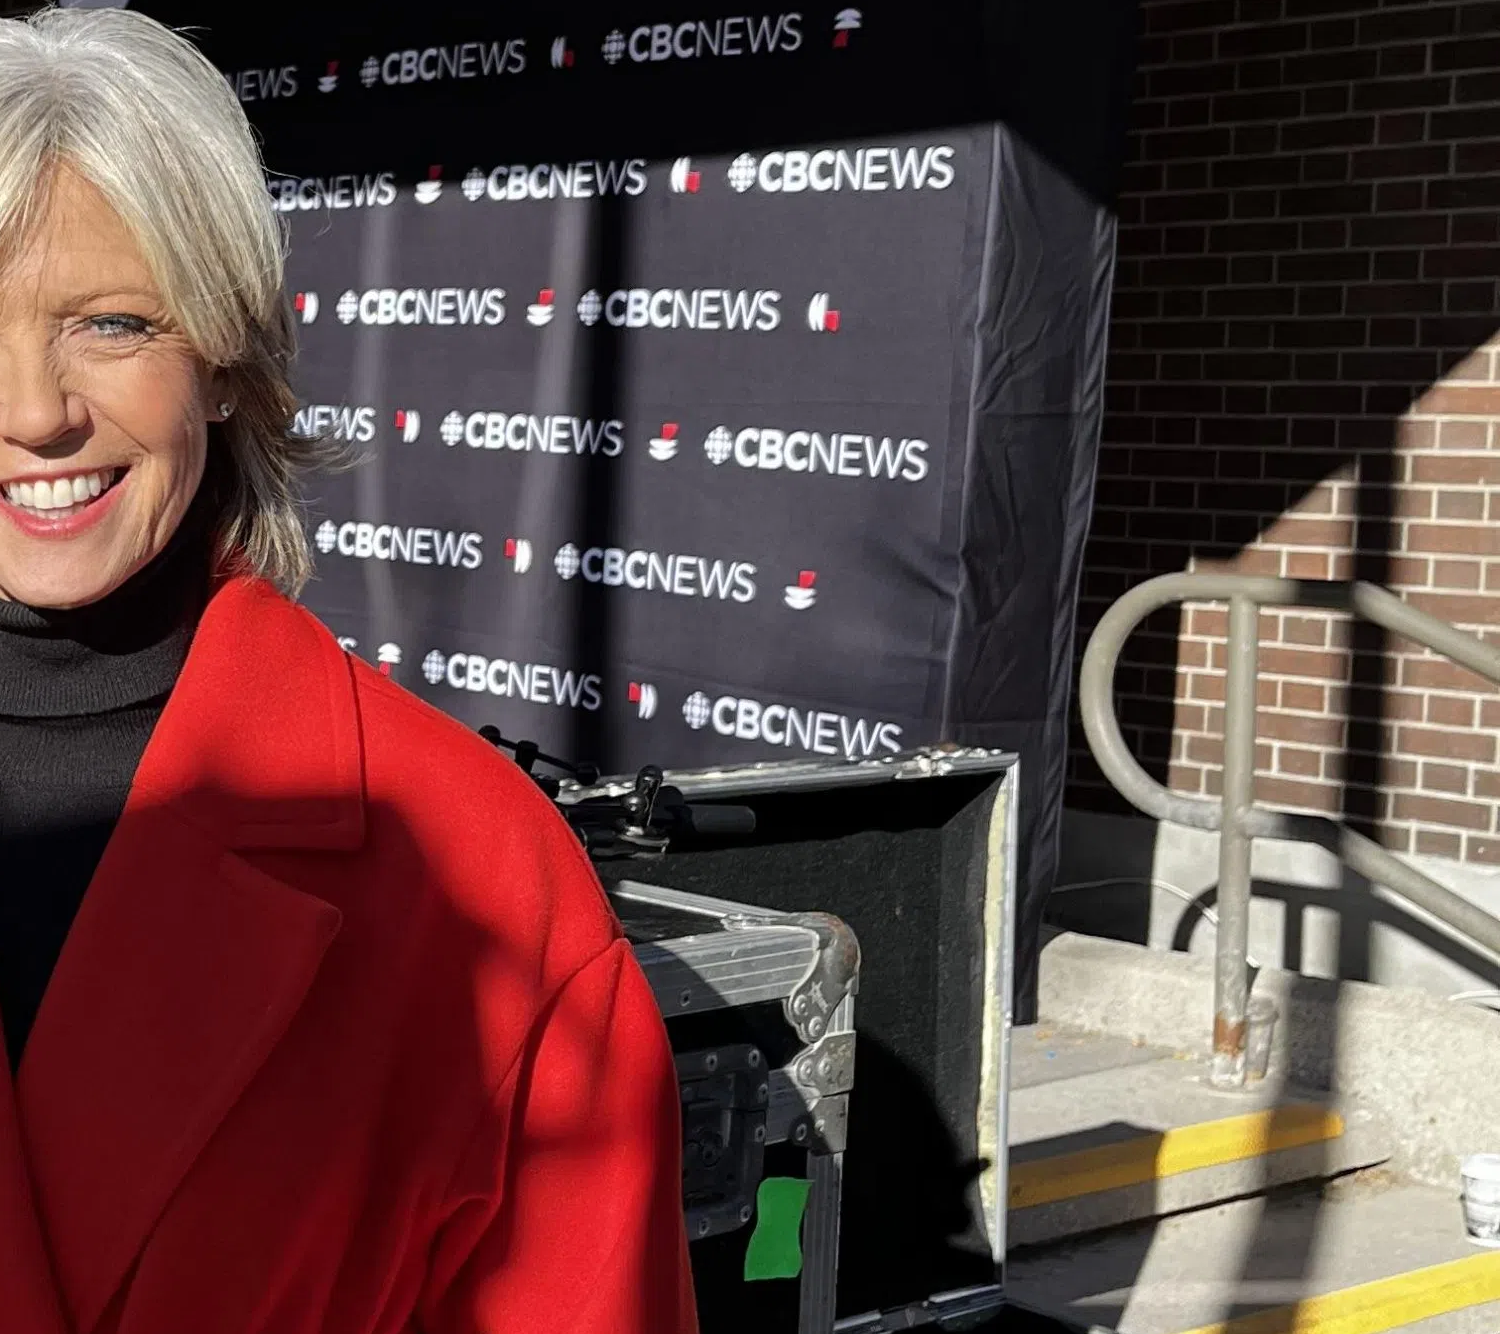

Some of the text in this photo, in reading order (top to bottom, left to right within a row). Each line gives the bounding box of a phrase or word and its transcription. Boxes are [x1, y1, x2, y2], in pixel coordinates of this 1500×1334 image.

[225, 12, 802, 101] NEWS CBCNEWS CBCNEWS
[488, 159, 648, 200] CBCNEWS
[758, 146, 955, 192] CBCNEWS
[360, 287, 781, 331] CBCNEWS CBCNEWS
[293, 405, 928, 481] NEWS CBCNEWS CBCNEWS
[338, 521, 756, 604] CBCNEWS CBCNEWS
[446, 654, 902, 757] CBCNEWS CBCNEWS
